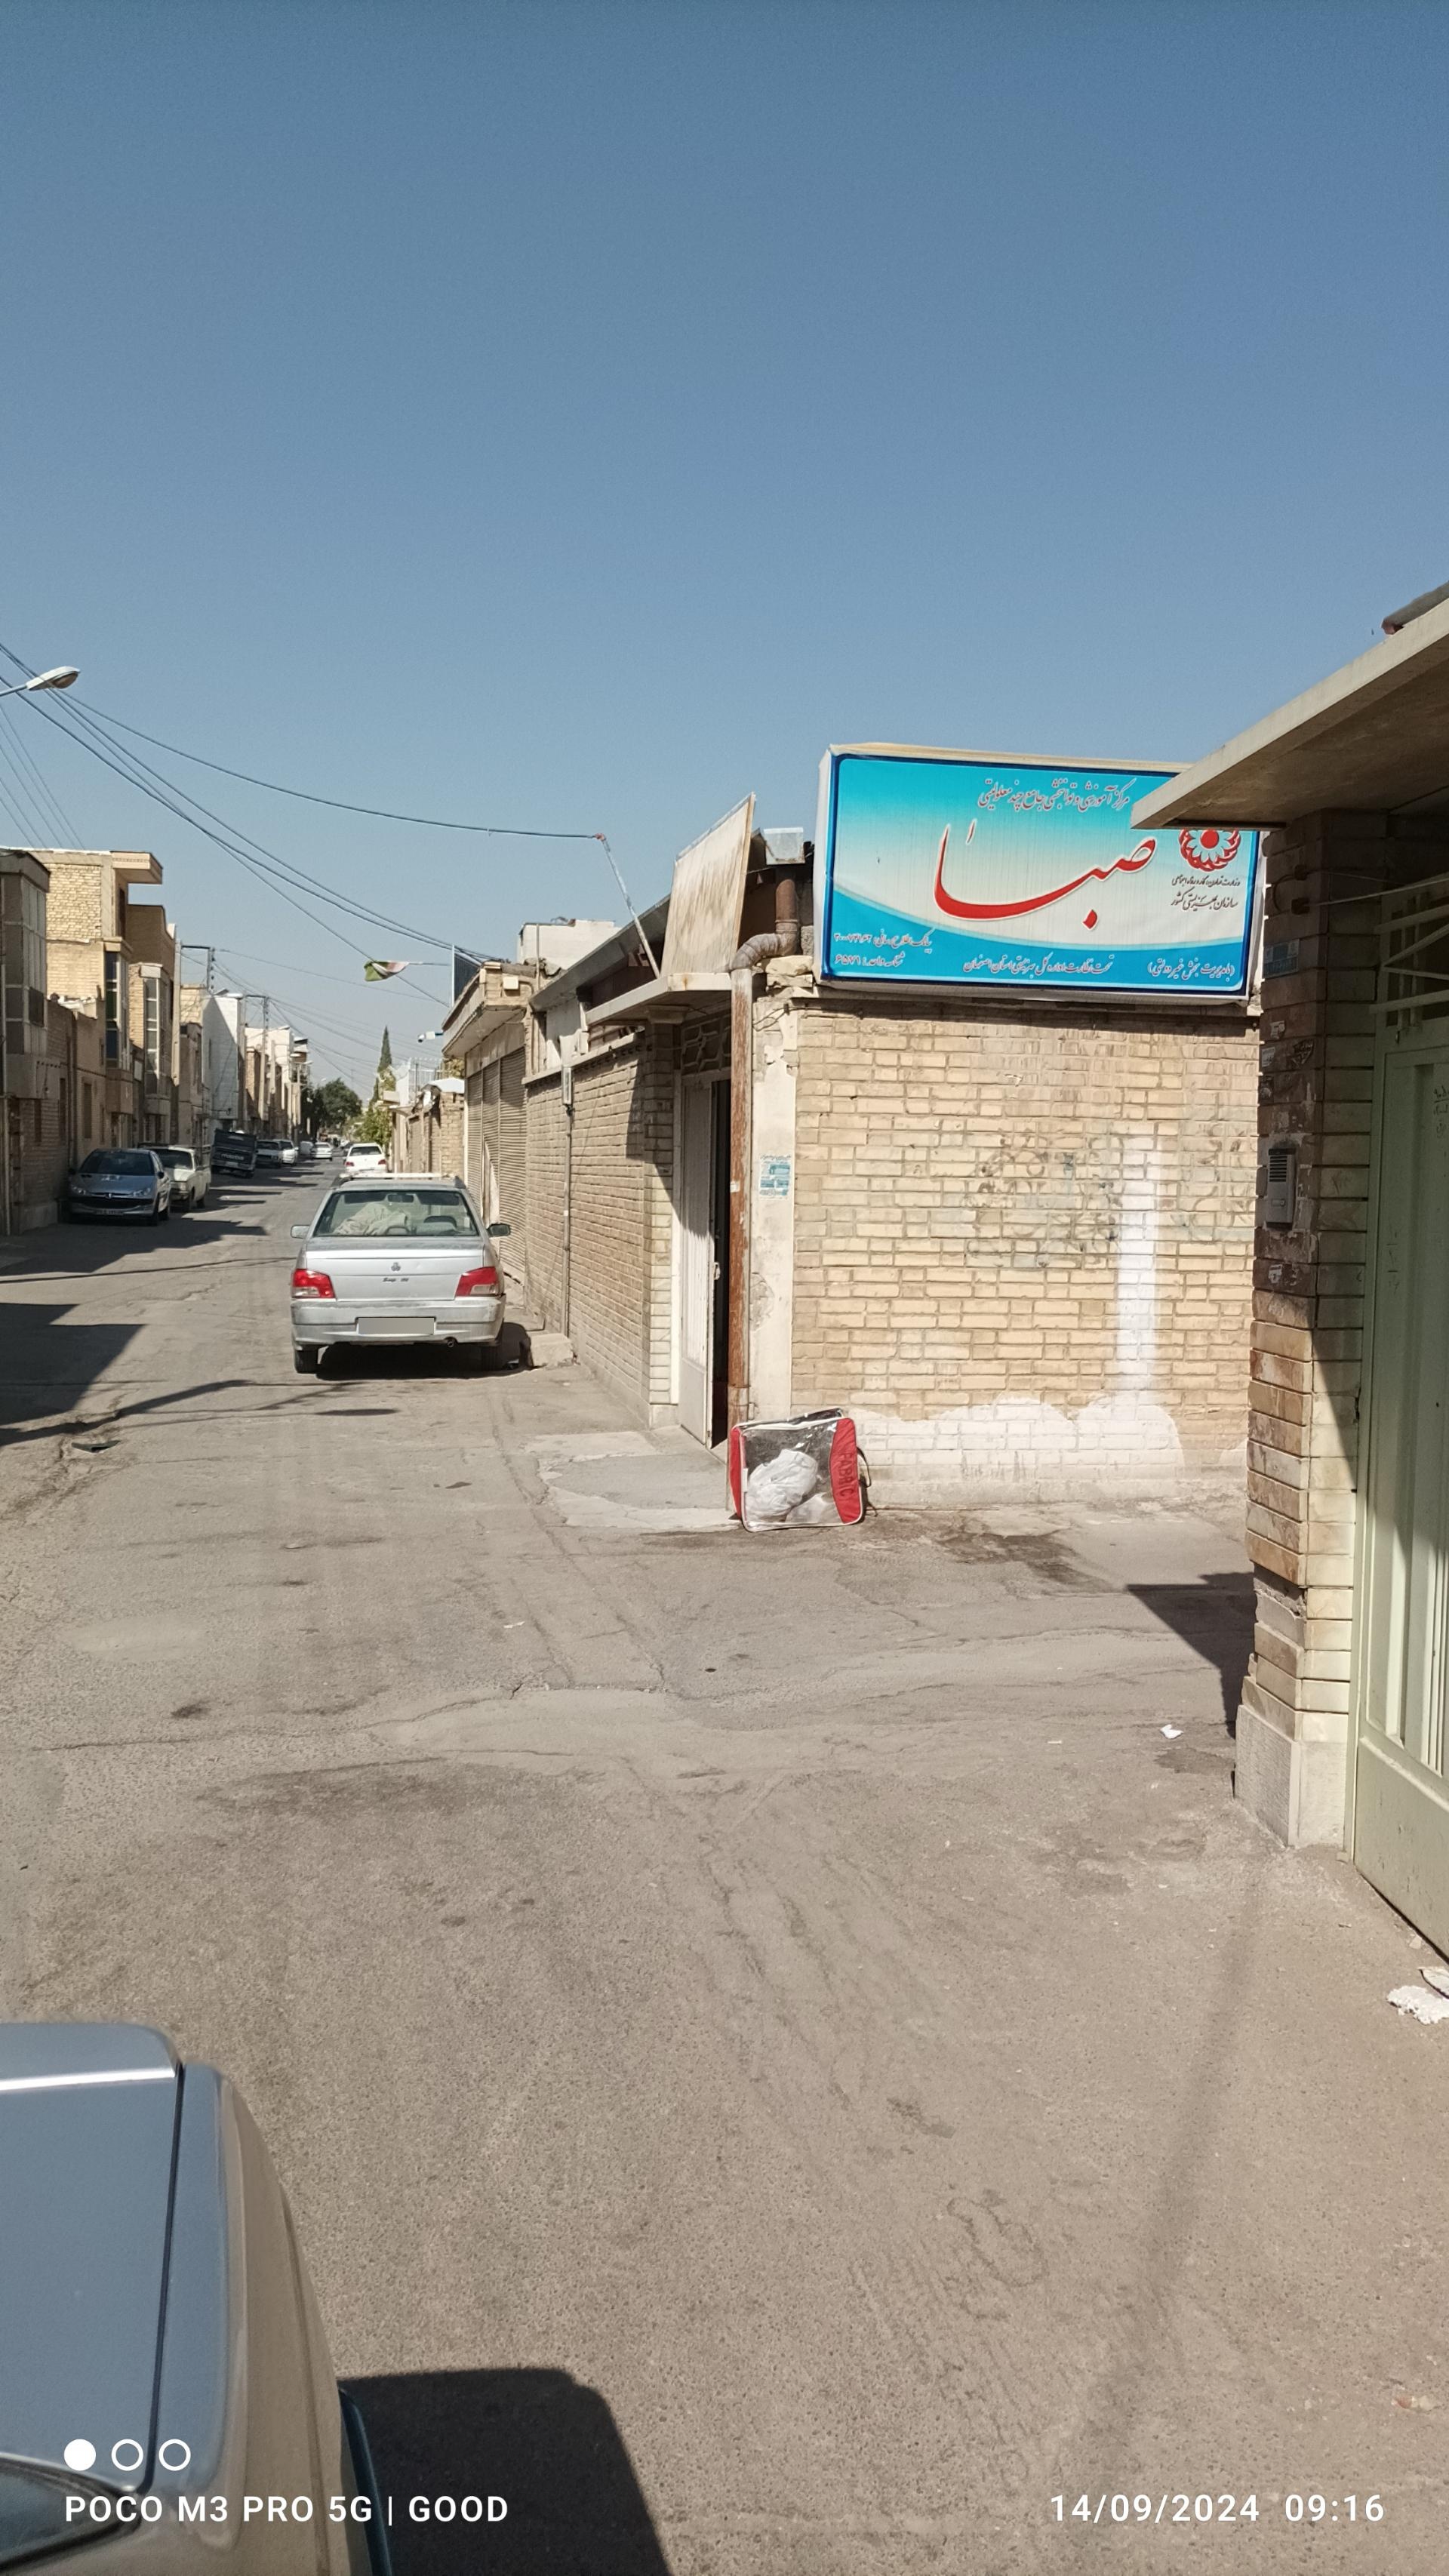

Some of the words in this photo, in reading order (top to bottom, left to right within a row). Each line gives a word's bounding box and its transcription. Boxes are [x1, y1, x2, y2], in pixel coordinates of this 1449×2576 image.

[978, 778, 1013, 811] معلولیتی
[1007, 779, 1024, 812] چند
[1022, 789, 1046, 811] جامع
[1043, 777, 1077, 811] توانبخشی
[1077, 780, 1118, 813] آموزشی
[1111, 777, 1137, 811] مرکز
[934, 819, 1158, 930] صبا
[1171, 886, 1195, 906] کشور
[1183, 894, 1218, 912] بهزیستی
[1214, 897, 1239, 910] سازمان
[963, 953, 992, 972] اصفهان
[990, 954, 1014, 974] استان
[1011, 956, 1037, 979] بهزیستی
[1035, 951, 1054, 976] کل
[1065, 958, 1094, 974] نظارت
[1091, 954, 1115, 974] تحت
[1181, 957, 1201, 980] بخش
[838, 1453, 854, 1497] FABRIC
